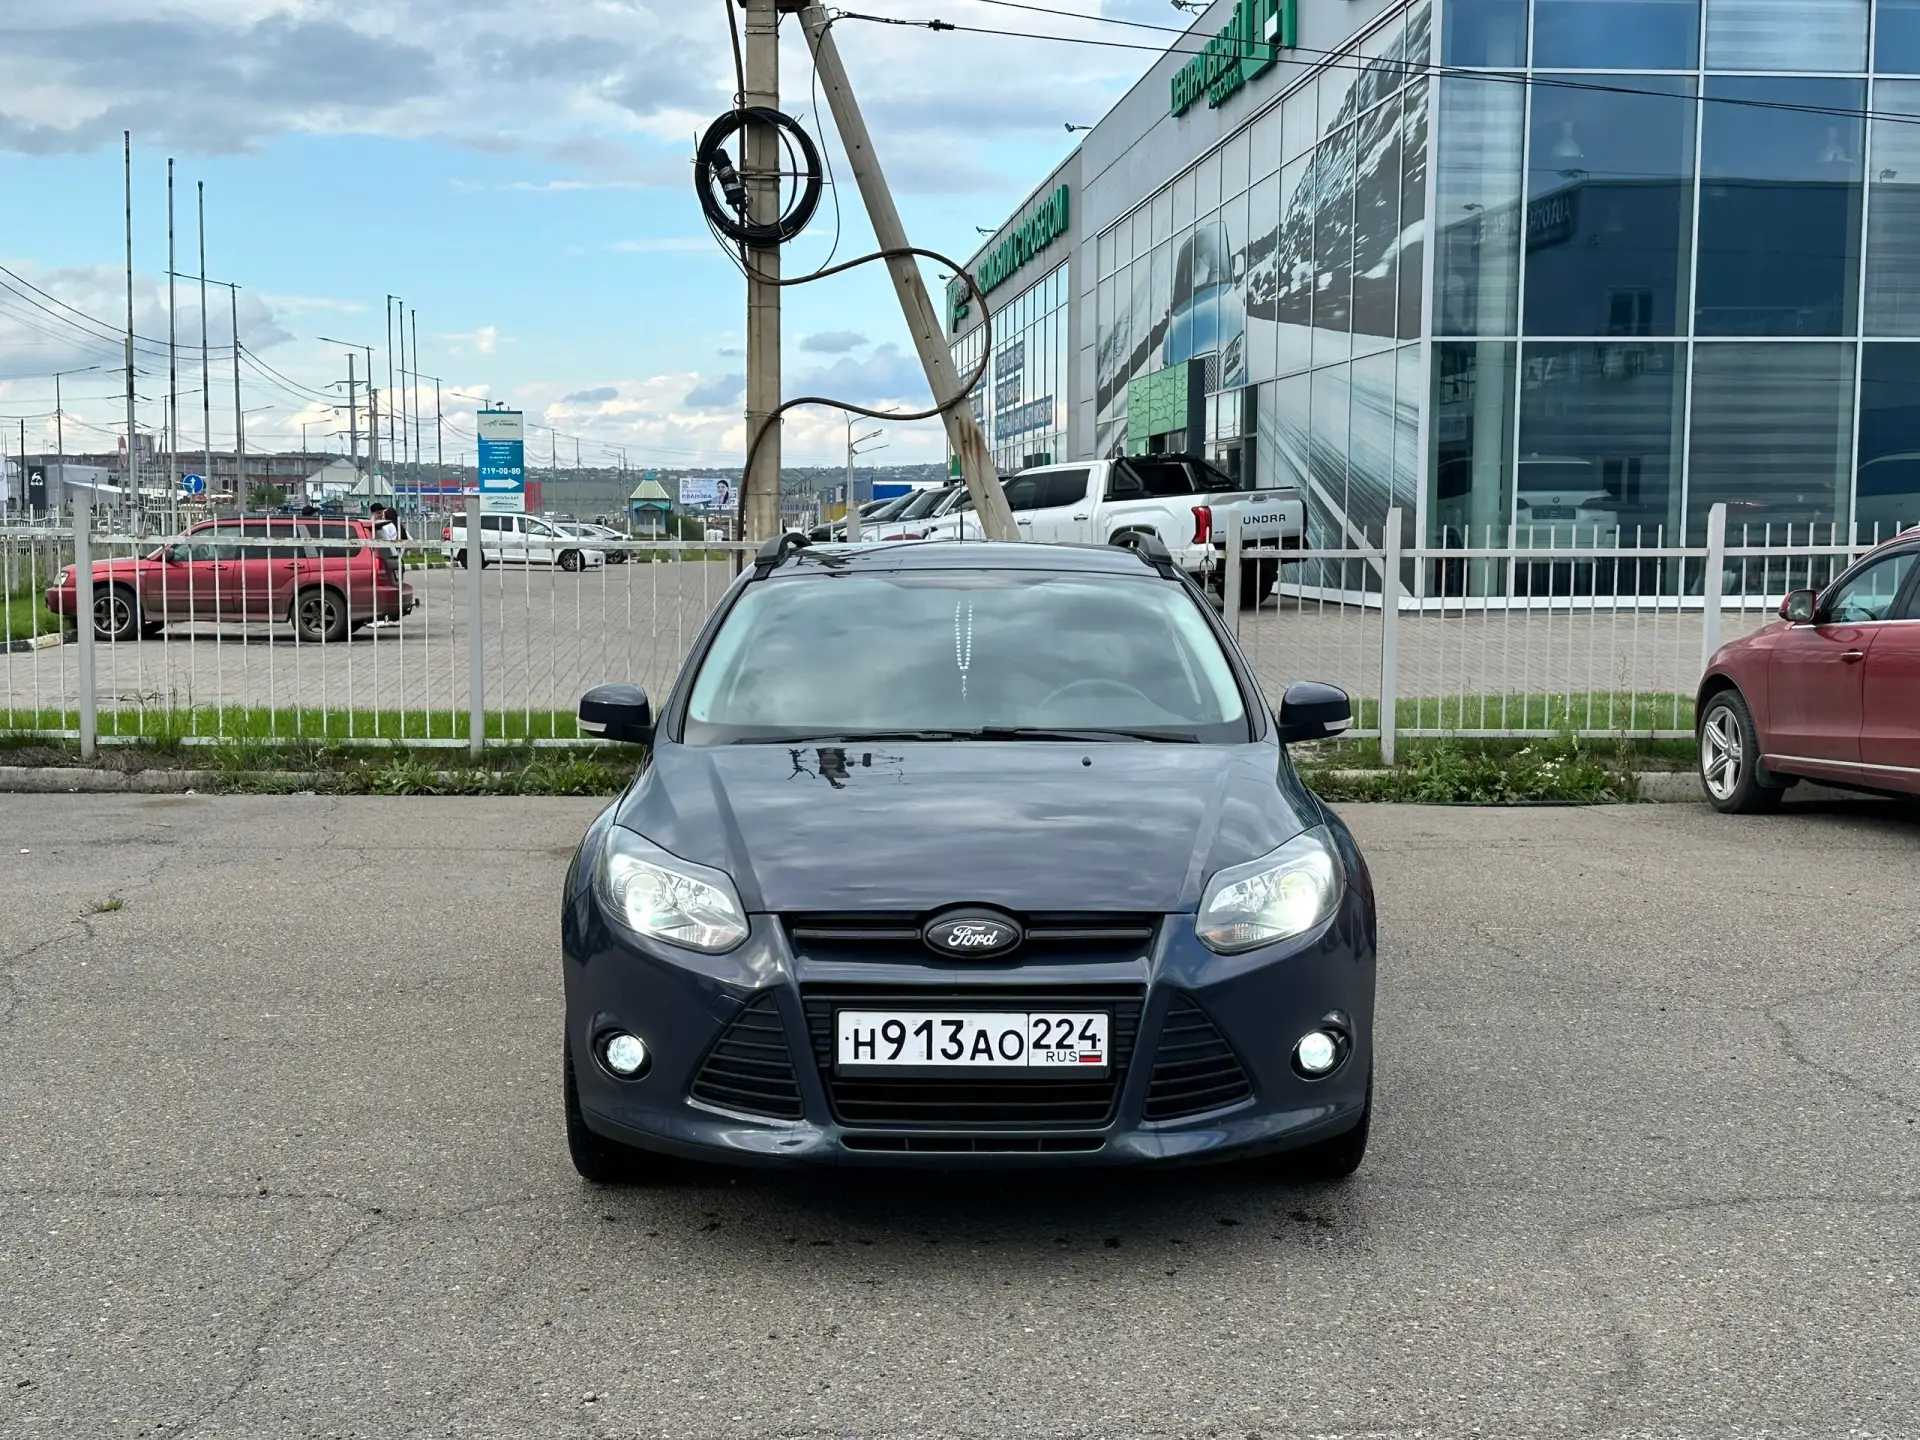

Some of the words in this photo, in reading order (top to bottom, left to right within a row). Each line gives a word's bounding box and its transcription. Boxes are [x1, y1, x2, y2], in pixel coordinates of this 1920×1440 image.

[1243, 514, 1286, 525] UNDRA
[948, 925, 998, 946] Ford
[1032, 1018, 1098, 1050] 224
[1046, 1051, 1078, 1063] RUS
